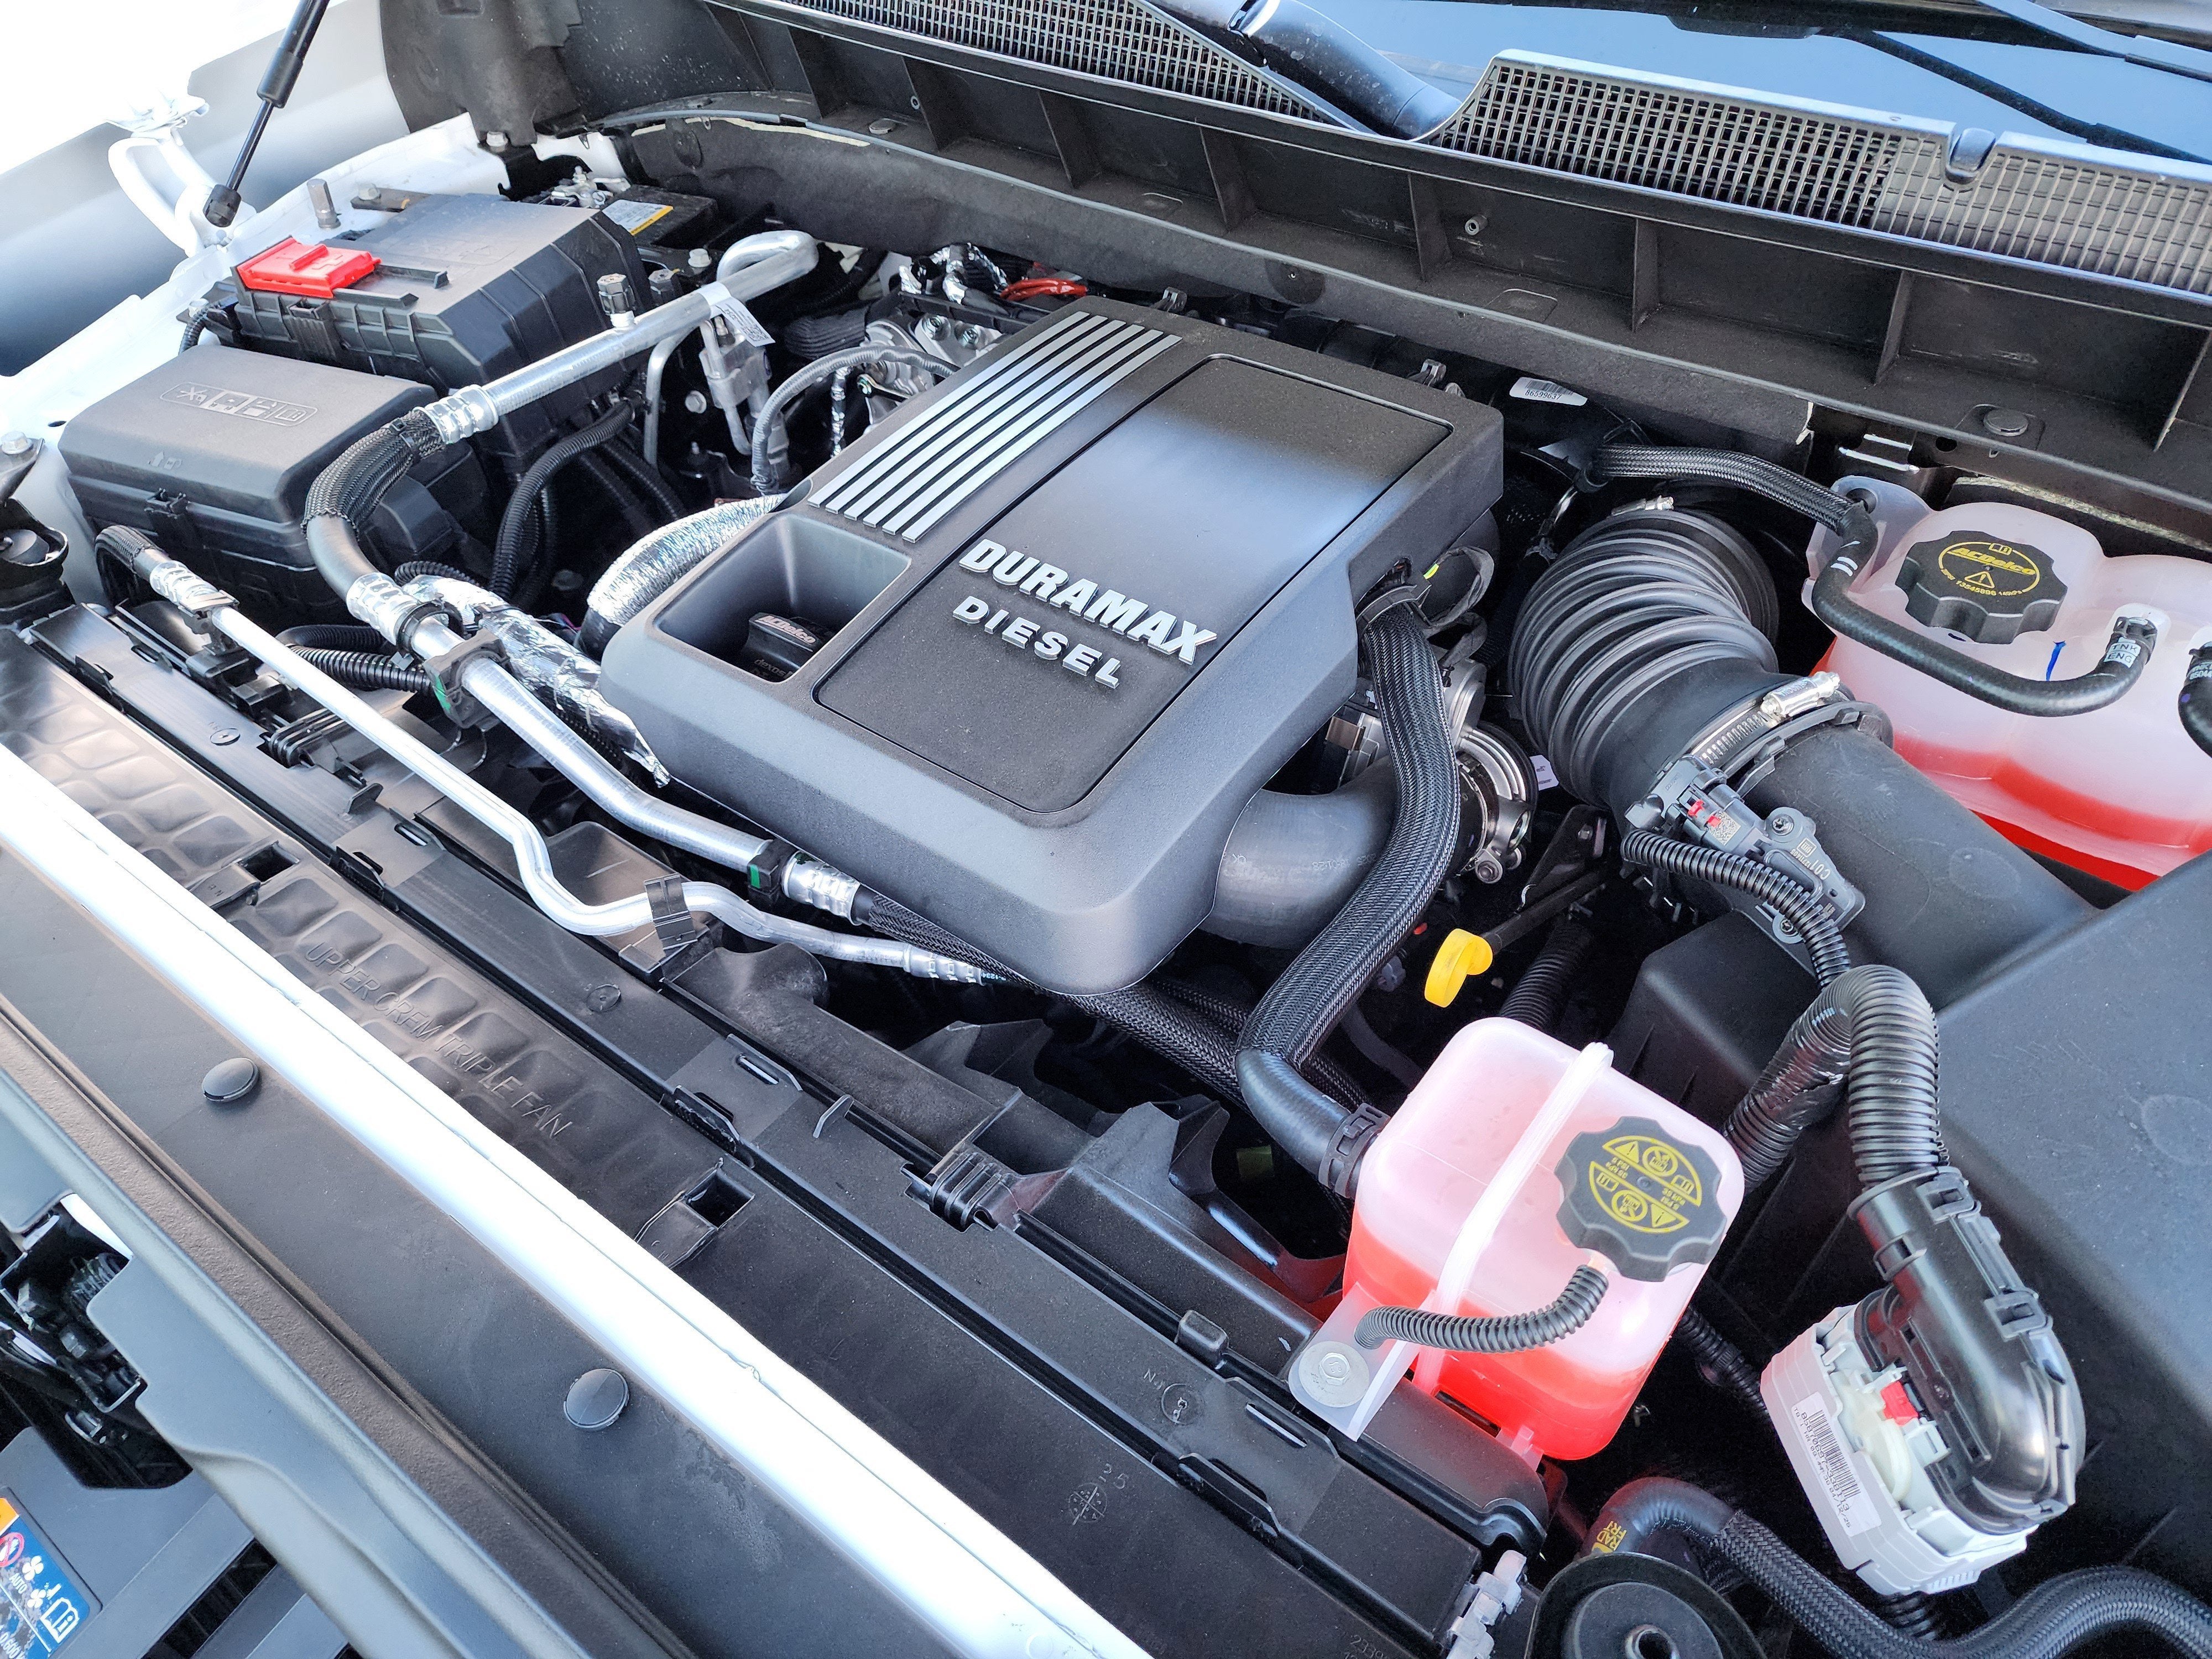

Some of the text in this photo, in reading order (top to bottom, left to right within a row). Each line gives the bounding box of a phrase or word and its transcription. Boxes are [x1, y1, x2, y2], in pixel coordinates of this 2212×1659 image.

[1525, 389, 1562, 400] 86599637
[1948, 547, 2037, 576] ACDelco
[959, 539, 1217, 665] DURAMAX
[757, 615, 816, 644] ACDelco
[952, 596, 1121, 689] DIESEL
[2111, 644, 2137, 653] TNK
[2107, 653, 2132, 663] ENG
[304, 941, 573, 1139] UPPER CRFM TRIPLE FAN
[1596, 1530, 1624, 1551] RAD
[8, 1572, 28, 1594] AUTO
